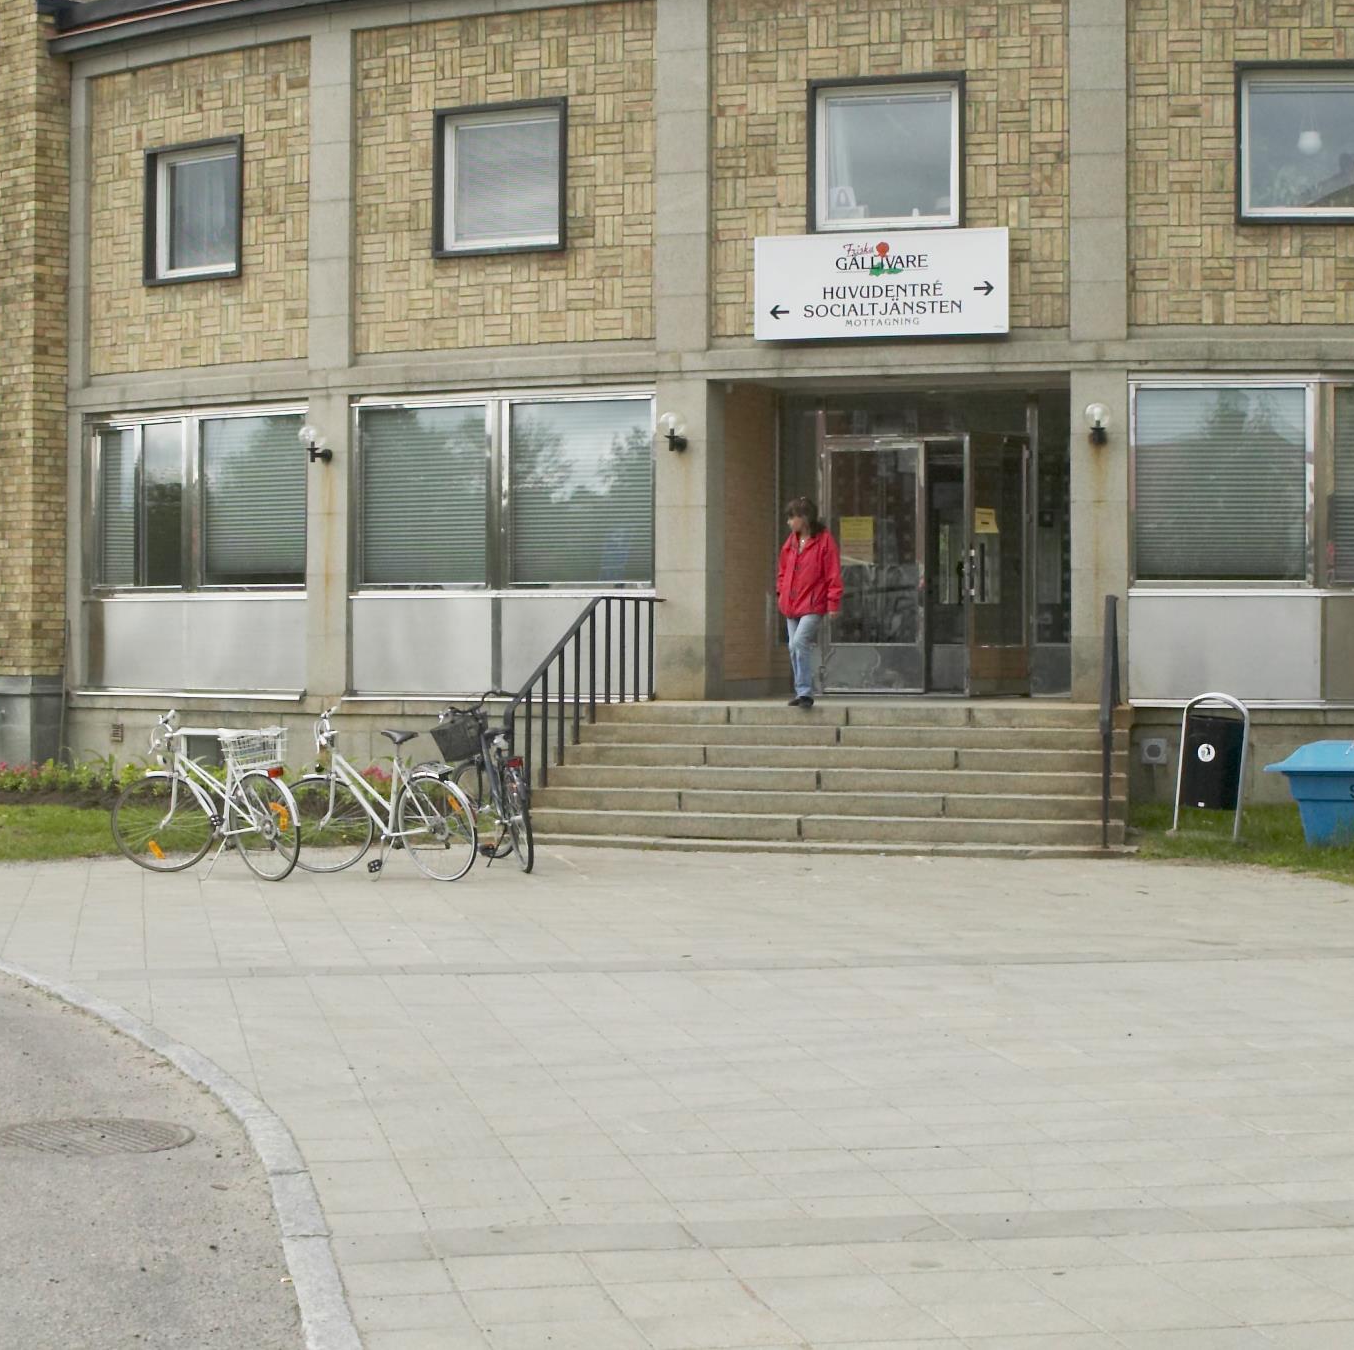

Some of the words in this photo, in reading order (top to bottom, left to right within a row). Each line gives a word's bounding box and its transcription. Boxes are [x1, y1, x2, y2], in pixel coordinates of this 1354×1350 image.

[835, 254, 929, 271] GÄLLIVARE
[822, 280, 944, 300] HUVUDENTRÉ
[803, 298, 963, 318] SOCIALTJÄNSTEN
[845, 317, 920, 327] MOTTAGNING
